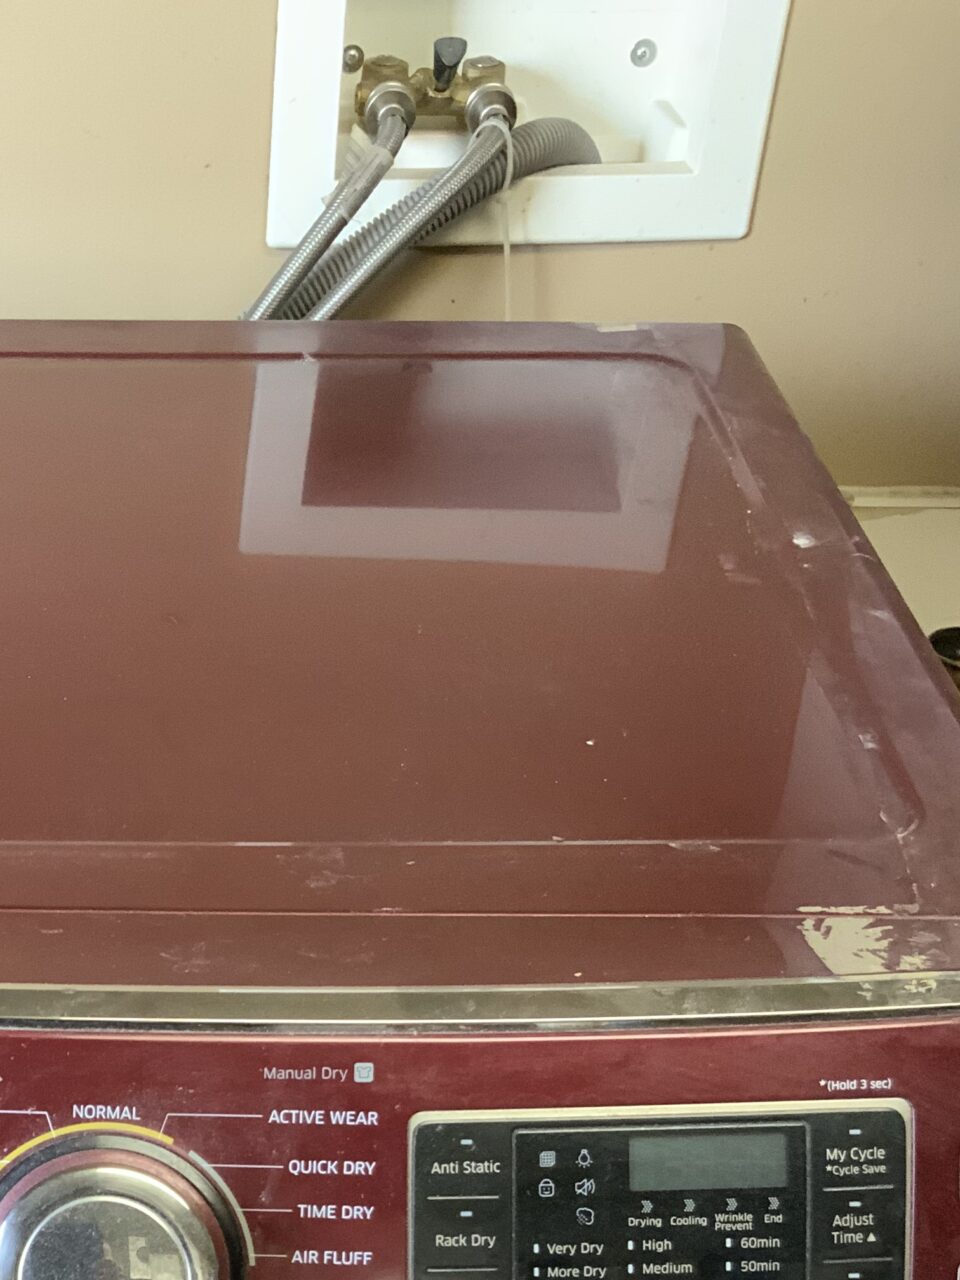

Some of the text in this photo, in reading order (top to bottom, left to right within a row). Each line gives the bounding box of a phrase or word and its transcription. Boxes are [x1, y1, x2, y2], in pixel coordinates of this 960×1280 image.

[263, 1066, 348, 1083] Manual Dry
[860, 1080, 867, 1090] 3
[870, 1078, 892, 1090] sec)
[72, 1105, 141, 1121] NORMAL
[268, 1110, 378, 1126] ACTIVE WEAR
[826, 1147, 886, 1163] My Cycle
[288, 1159, 376, 1176] QUICK DRY
[431, 1160, 501, 1174] Anti Static
[862, 1164, 887, 1174] Save
[297, 1204, 374, 1220] TIME DRY
[715, 1213, 753, 1223] Wrinkle
[764, 1214, 783, 1223] End
[628, 1217, 662, 1228] Drying
[670, 1216, 708, 1226] Cooling
[715, 1221, 753, 1231] Prevent
[832, 1213, 874, 1228] Adjust
[435, 1234, 496, 1250] Rack Dry
[740, 1236, 781, 1249] 60min
[831, 1232, 863, 1244] Time
[547, 1243, 604, 1257] Very Dry
[642, 1239, 672, 1252] High
[292, 1250, 372, 1265] AIR FLUFF
[547, 1266, 607, 1280] More Dry
[642, 1263, 693, 1275] Medium
[740, 1260, 780, 1273] 50min
